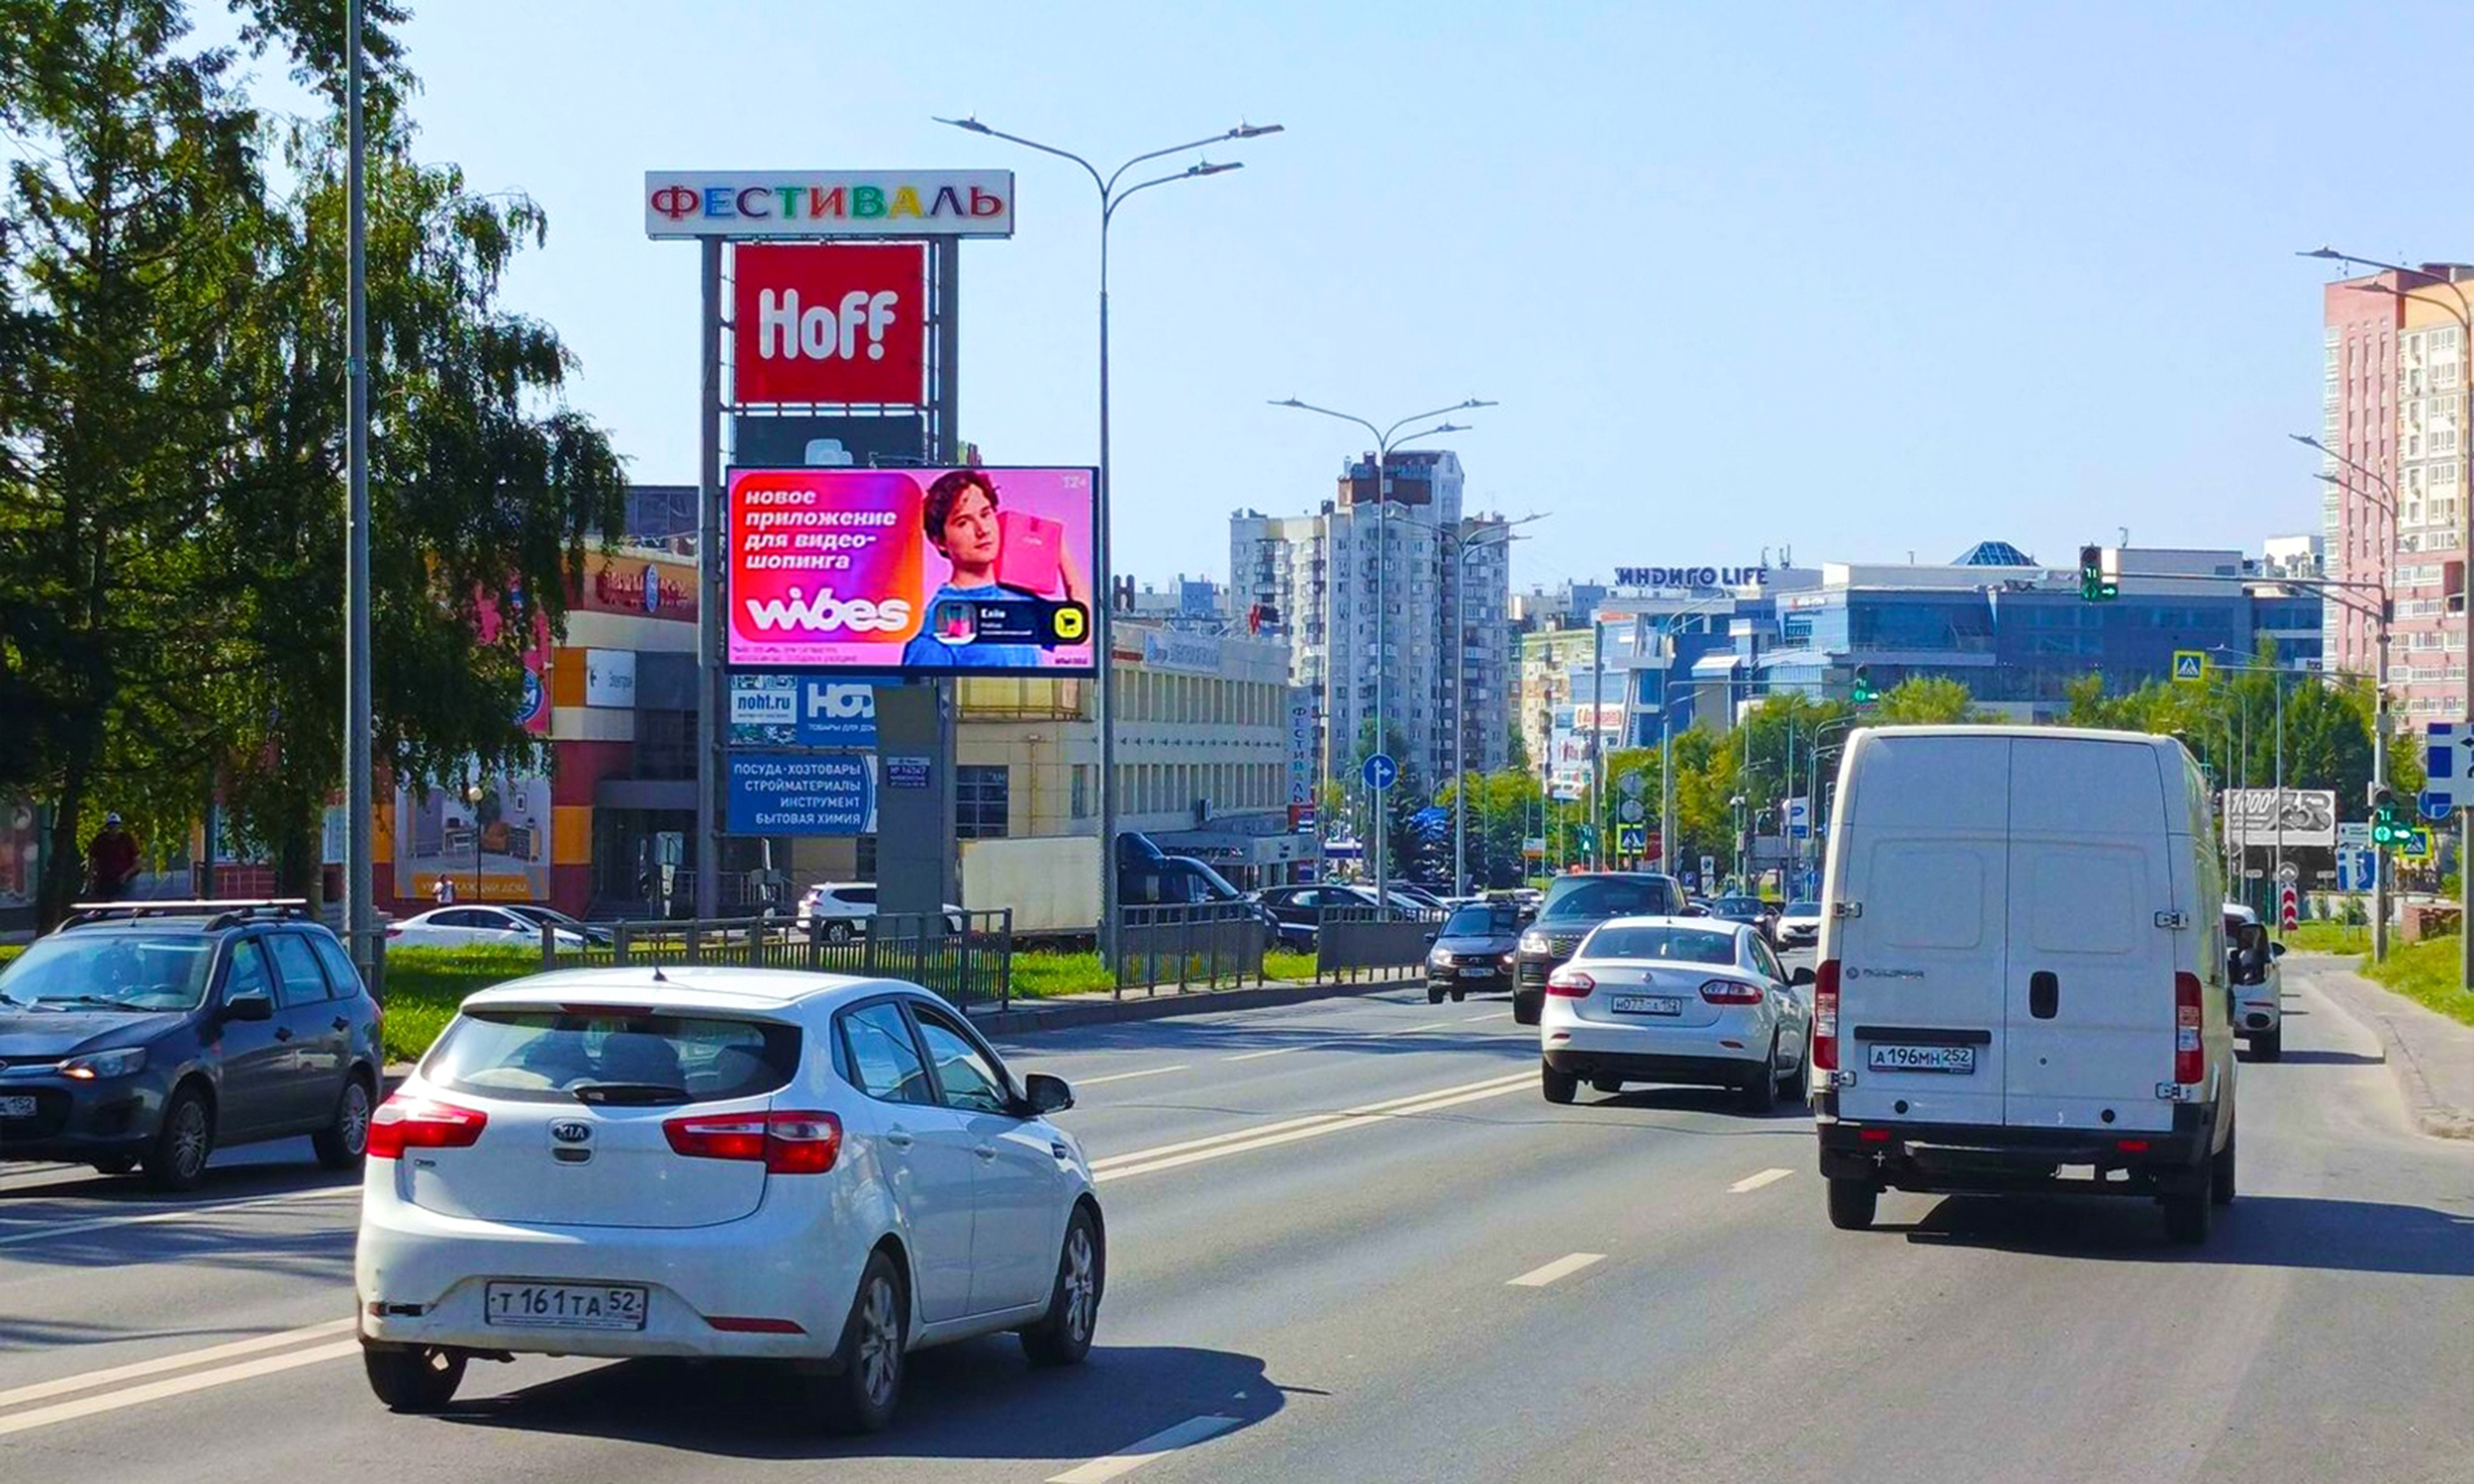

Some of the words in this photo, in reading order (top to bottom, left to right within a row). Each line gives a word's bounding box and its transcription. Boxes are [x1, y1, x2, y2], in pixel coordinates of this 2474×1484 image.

[650, 185, 1003, 220] ФЕСТИВАЛЬ
[745, 510, 898, 531] приложение
[744, 533, 790, 551] для
[795, 533, 877, 550] видео-
[745, 554, 850, 569] шопинга
[1722, 567, 1768, 585] LIFE
[745, 587, 911, 631] wibes
[737, 694, 791, 709] noht.ru
[1292, 707, 1306, 803] ФЕСТИВАЛЬ
[745, 779, 861, 792] СТРОЙМАТЕРИАЛЫ
[780, 796, 860, 808] ИНСТРУМЕНТ
[756, 813, 815, 824] БЫТОВАЯ
[817, 813, 861, 824] ХИМИЯ
[1943, 1049, 1970, 1063] 252
[555, 1124, 585, 1138] KIA
[610, 1290, 635, 1312] 52
